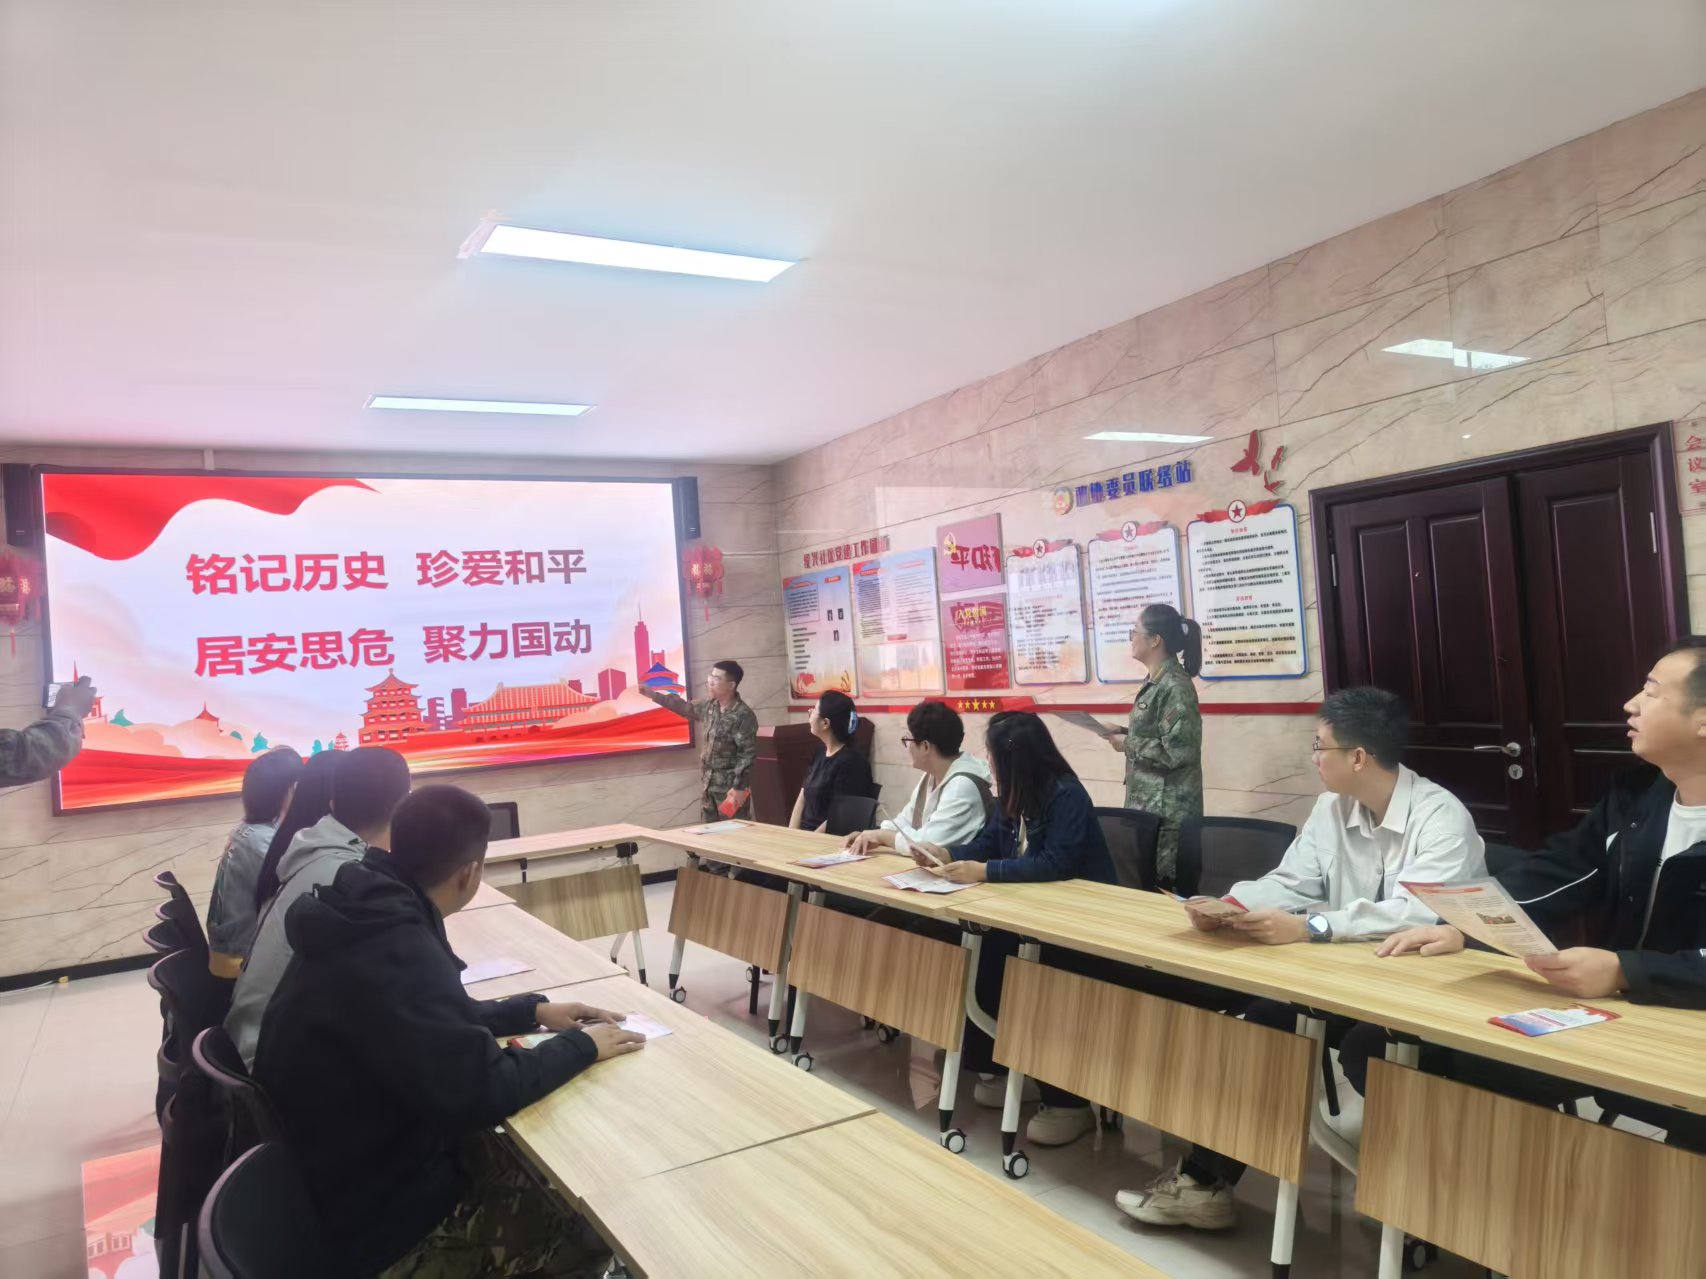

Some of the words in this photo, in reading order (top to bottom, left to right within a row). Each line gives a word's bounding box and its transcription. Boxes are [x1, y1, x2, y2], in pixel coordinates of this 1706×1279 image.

[186, 552, 389, 596] 铭记历史
[416, 548, 588, 588] 珍爱和平
[194, 627, 395, 678] 居安思危
[423, 619, 593, 664] 聚力国动
